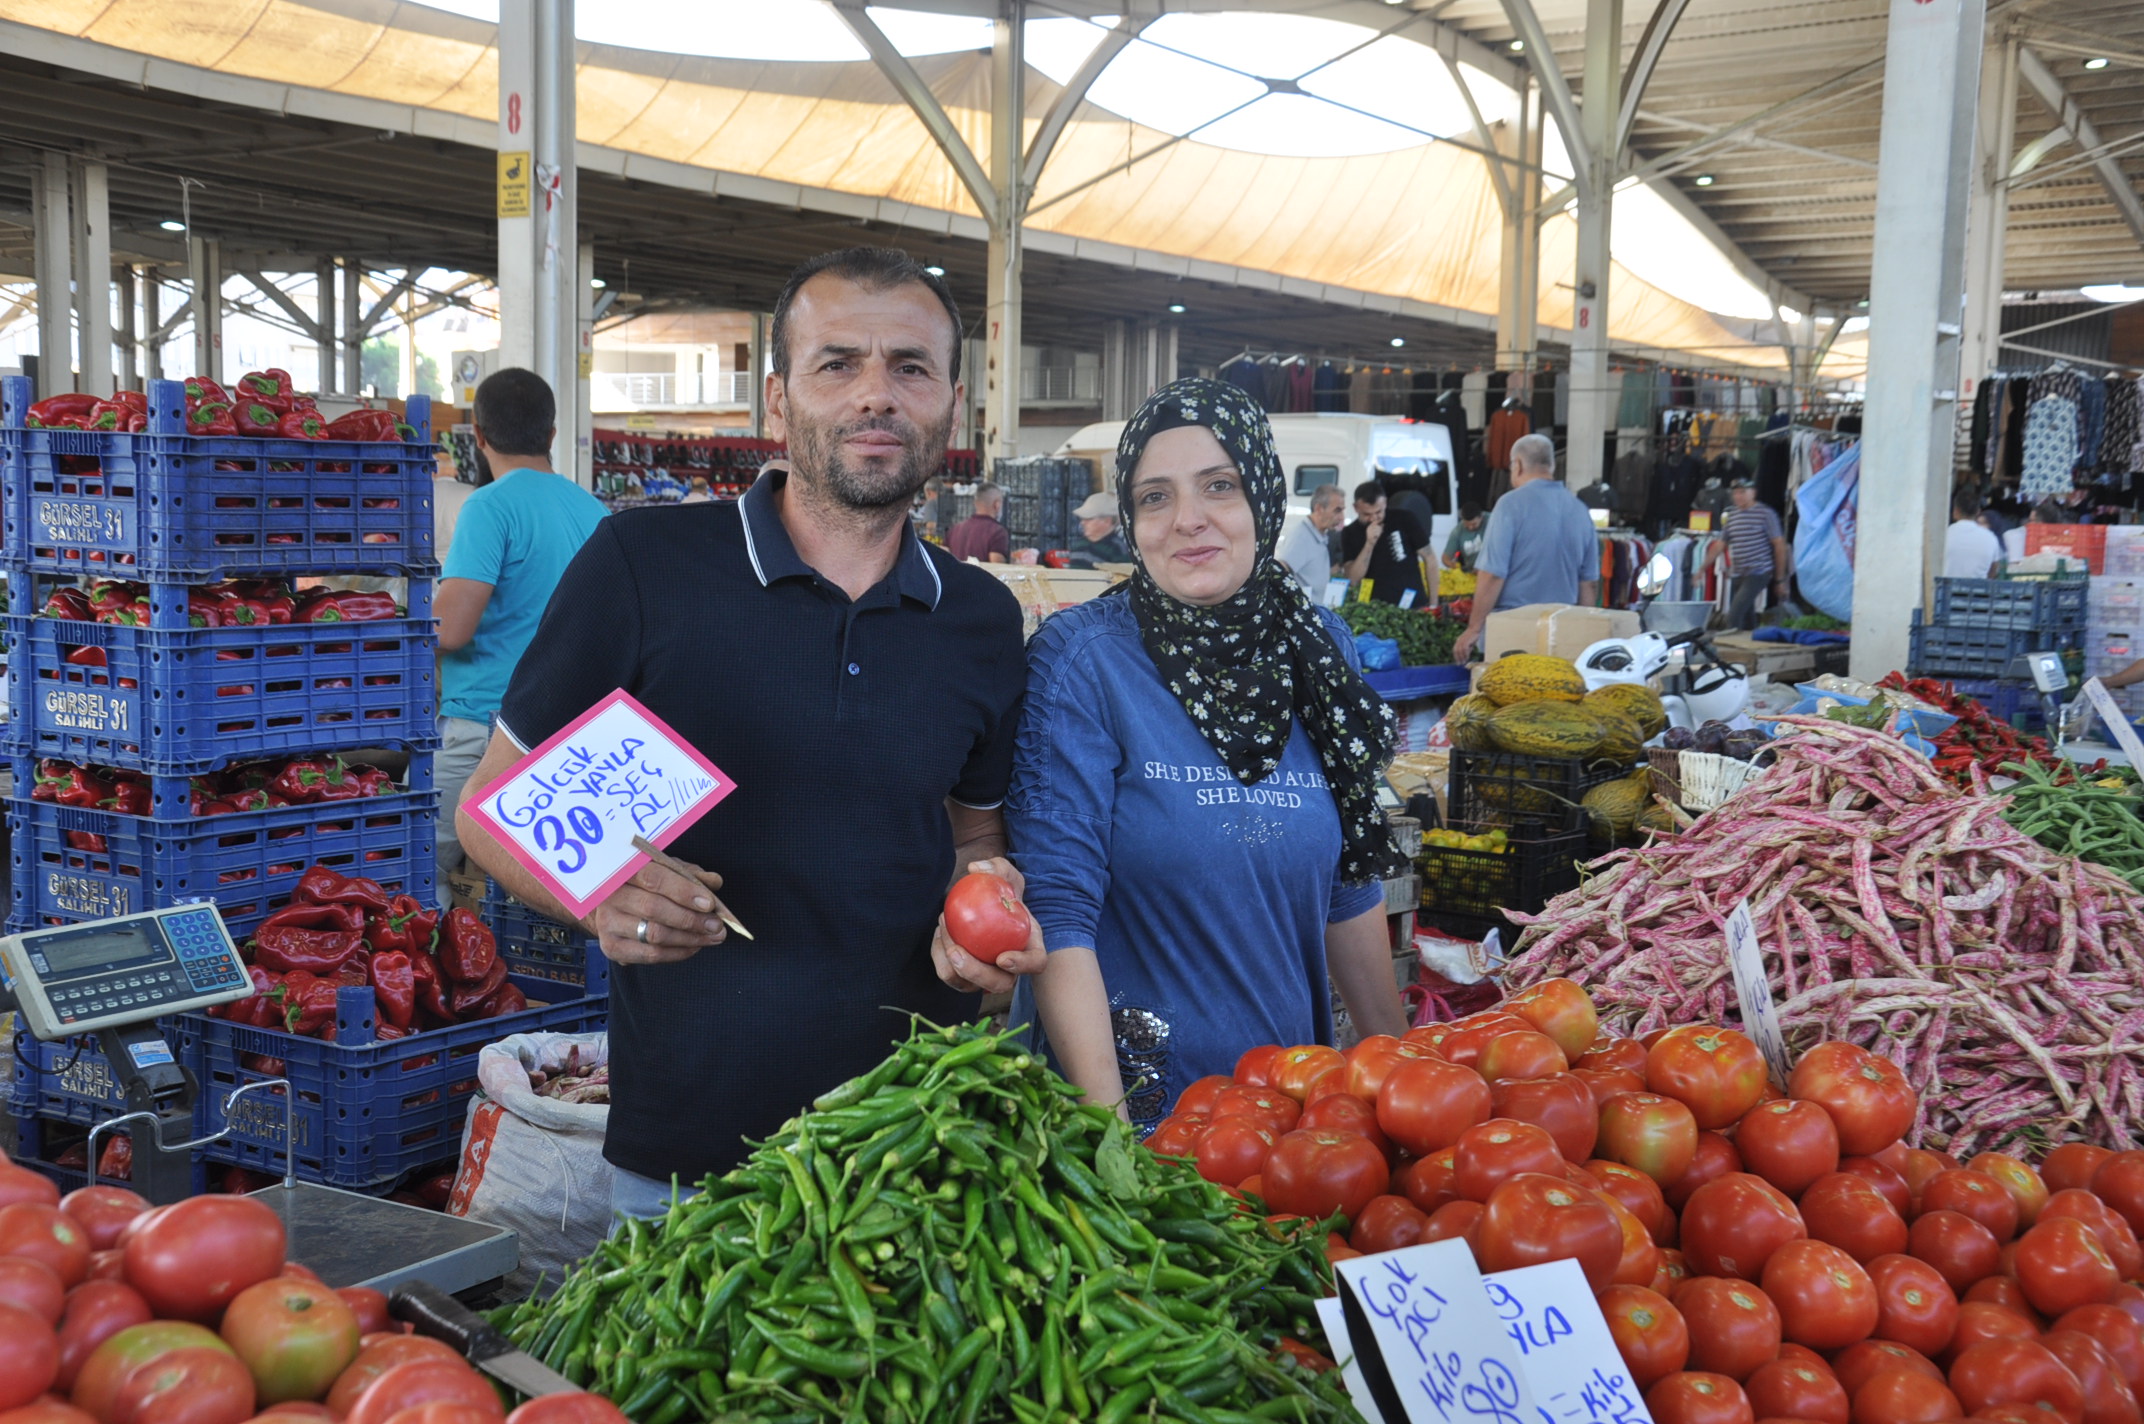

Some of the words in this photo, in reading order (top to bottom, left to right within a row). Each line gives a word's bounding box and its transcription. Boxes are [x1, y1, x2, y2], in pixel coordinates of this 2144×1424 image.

[507, 91, 521, 135] 8
[991, 321, 1000, 341] 7
[1579, 306, 1589, 329] 8
[104, 508, 123, 541] 31
[46, 689, 109, 719] GÜRSEL
[110, 698, 129, 731] 31
[1144, 761, 1181, 782] SHE
[1285, 770, 1299, 787] A
[1196, 786, 1240, 806] SHE
[1243, 786, 1302, 809] LOVED
[112, 885, 130, 917] 31
